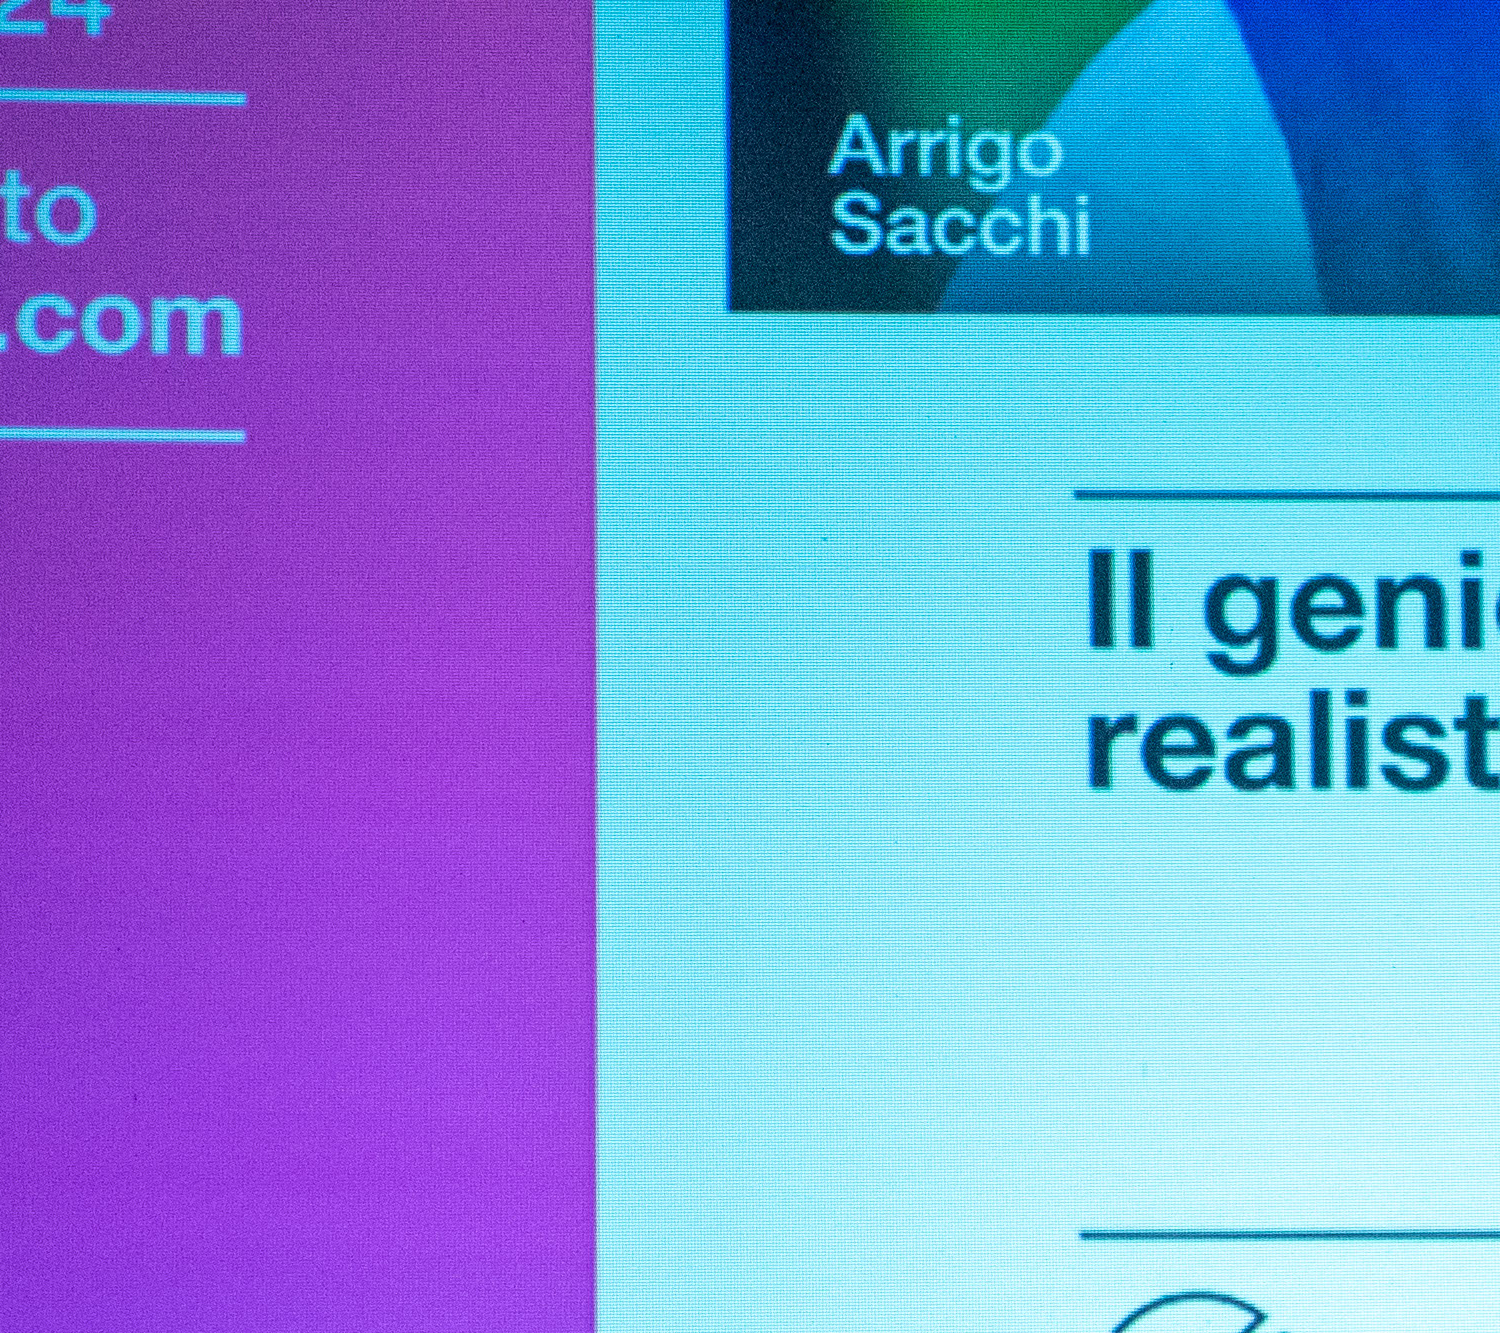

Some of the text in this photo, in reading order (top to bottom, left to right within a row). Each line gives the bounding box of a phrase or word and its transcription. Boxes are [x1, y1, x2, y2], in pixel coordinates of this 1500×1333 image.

[828, 113, 1064, 192] Arrigo
[831, 189, 1091, 256] Sacchi
[1089, 549, 1153, 649] Il
